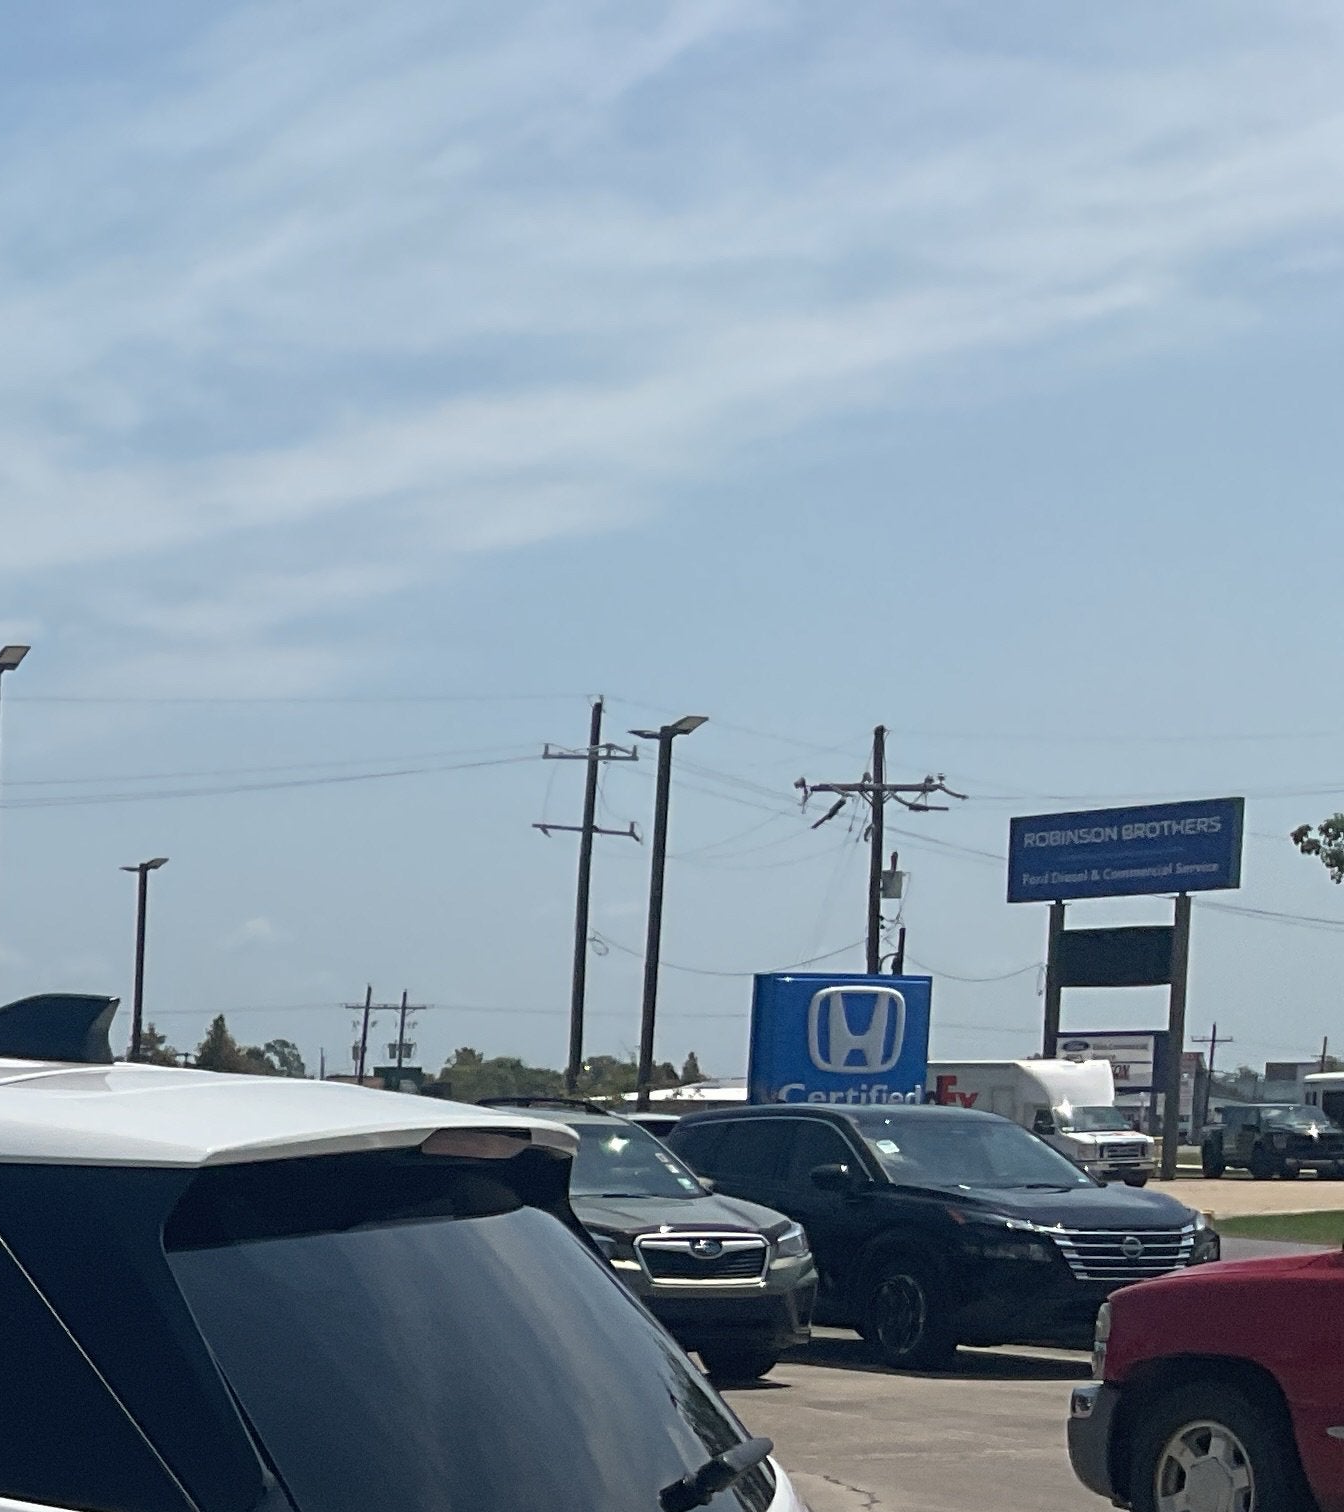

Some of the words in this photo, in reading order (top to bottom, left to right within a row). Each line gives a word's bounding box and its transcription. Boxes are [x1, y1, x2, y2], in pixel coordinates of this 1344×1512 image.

[1024, 826, 1118, 848] ROBINSON
[1121, 816, 1222, 840] BROTHERS
[777, 1082, 922, 1105] Certified
